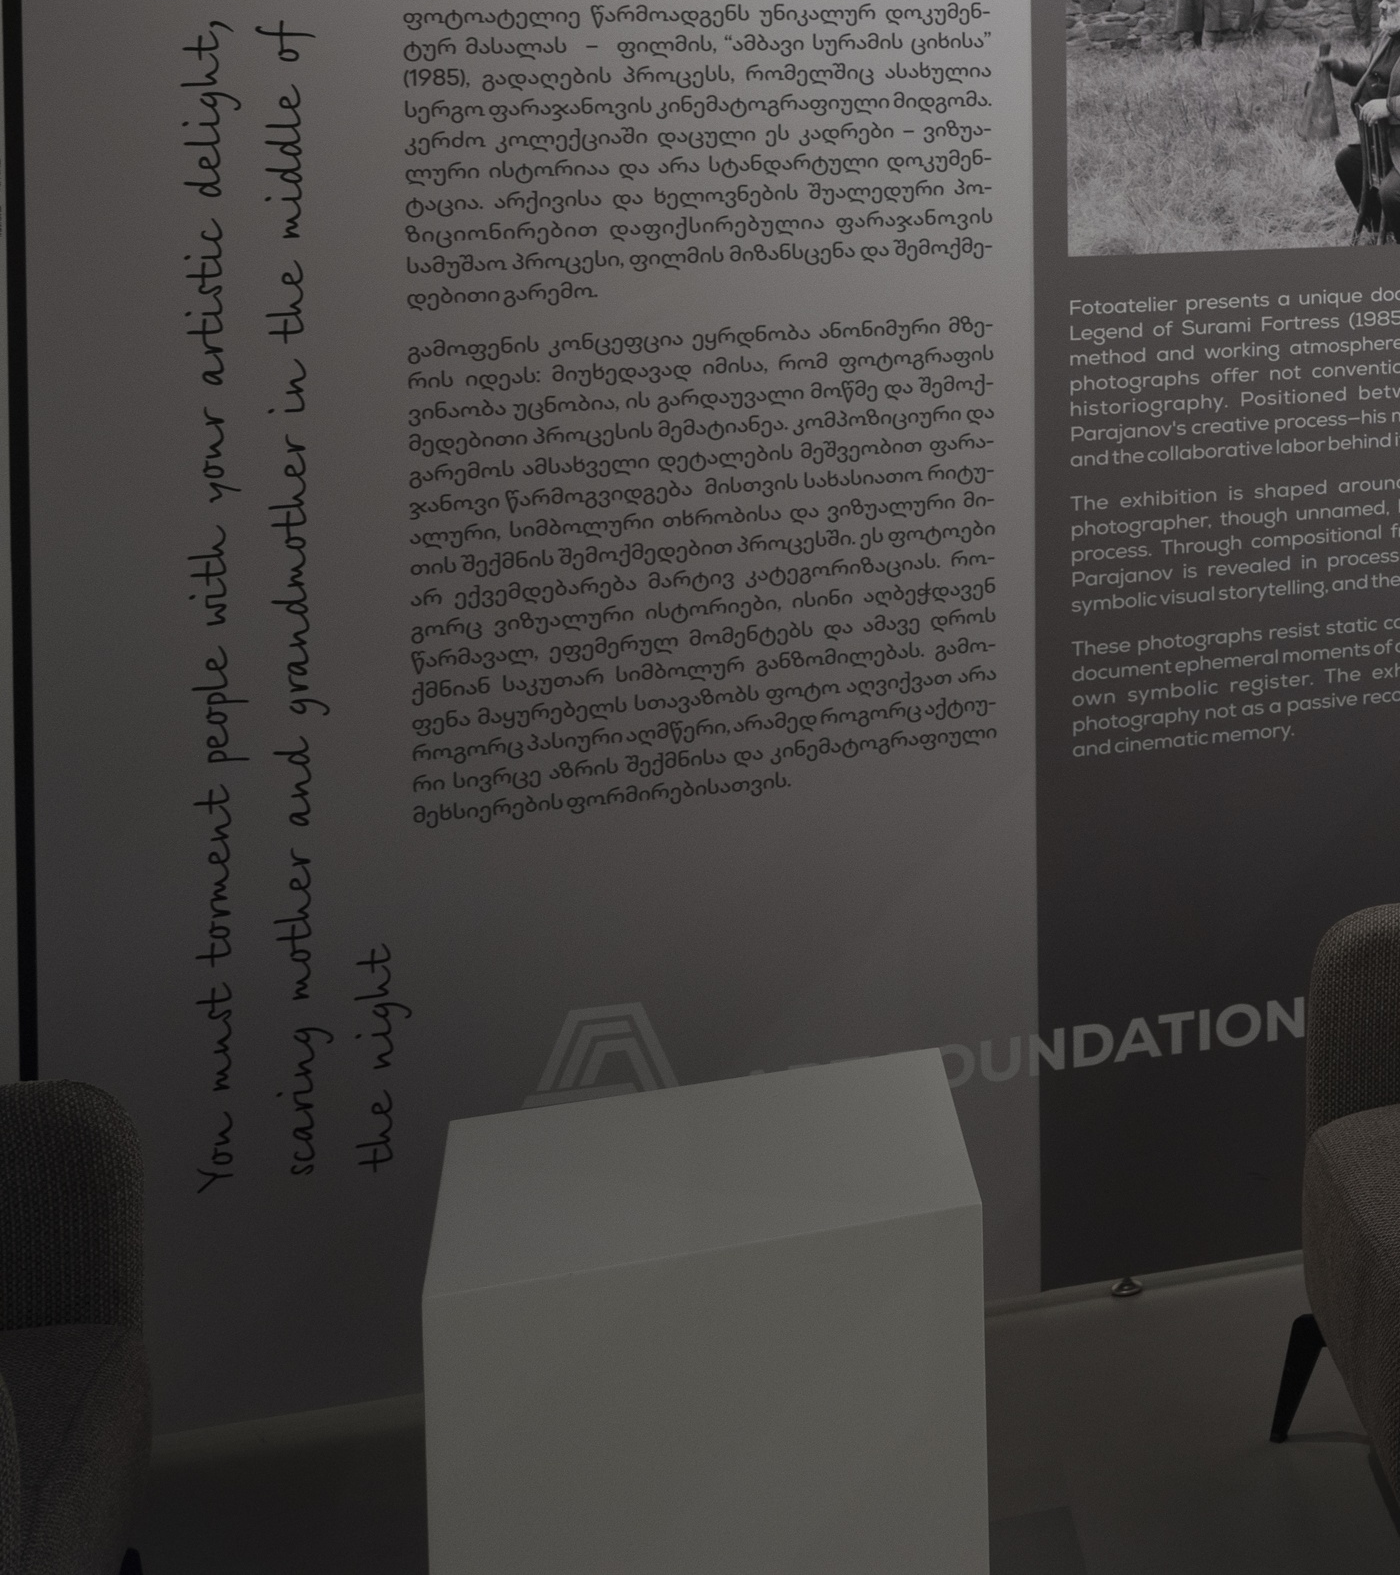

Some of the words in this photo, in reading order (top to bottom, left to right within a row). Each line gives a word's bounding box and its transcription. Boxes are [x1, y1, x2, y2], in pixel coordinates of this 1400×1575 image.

[254, 19, 316, 62] of
[180, 19, 242, 198] delight,
[264, 83, 303, 239] middle
[186, 217, 224, 386] artistic
[264, 259, 305, 344] the
[1070, 297, 1178, 315] Fotoatelier
[1186, 293, 1270, 315] presents
[1278, 295, 1290, 306] a
[1299, 289, 1363, 308] unique
[1070, 322, 1143, 345] Legend
[1153, 321, 1173, 337] of
[1182, 317, 1251, 336] Surami
[1261, 316, 1340, 331] Fortress
[267, 358, 307, 414] in
[1070, 347, 1146, 366] method
[1156, 345, 1194, 362] and
[1204, 342, 1280, 362] working
[1070, 371, 1200, 396] photographs
[1211, 367, 1259, 384] offer
[1270, 366, 1301, 380] not
[1070, 394, 1228, 418] historiography.
[1241, 386, 1347, 407] Positioned
[1191, 417, 1269, 435] creative
[202, 405, 242, 503] your
[1070, 450, 1109, 467] and
[1112, 449, 1144, 464] the
[1147, 441, 1273, 462] collaborative
[1276, 438, 1326, 454] labor
[1328, 432, 1391, 451] behind
[187, 525, 228, 626] with
[268, 433, 331, 716] grandmother
[1071, 640, 1131, 656] These
[1138, 627, 1262, 655] photographs
[1269, 623, 1320, 639] resist
[1326, 617, 1377, 635] static
[191, 645, 250, 764] people
[273, 735, 313, 827] and
[193, 783, 232, 968] torment
[273, 847, 313, 1001] mother
[195, 981, 232, 1092] must
[354, 943, 413, 1070] night
[938, 995, 1307, 1090] OUNDATION
[276, 1027, 334, 1176] scaring
[354, 1089, 394, 1173] the
[197, 1110, 234, 1195] You
